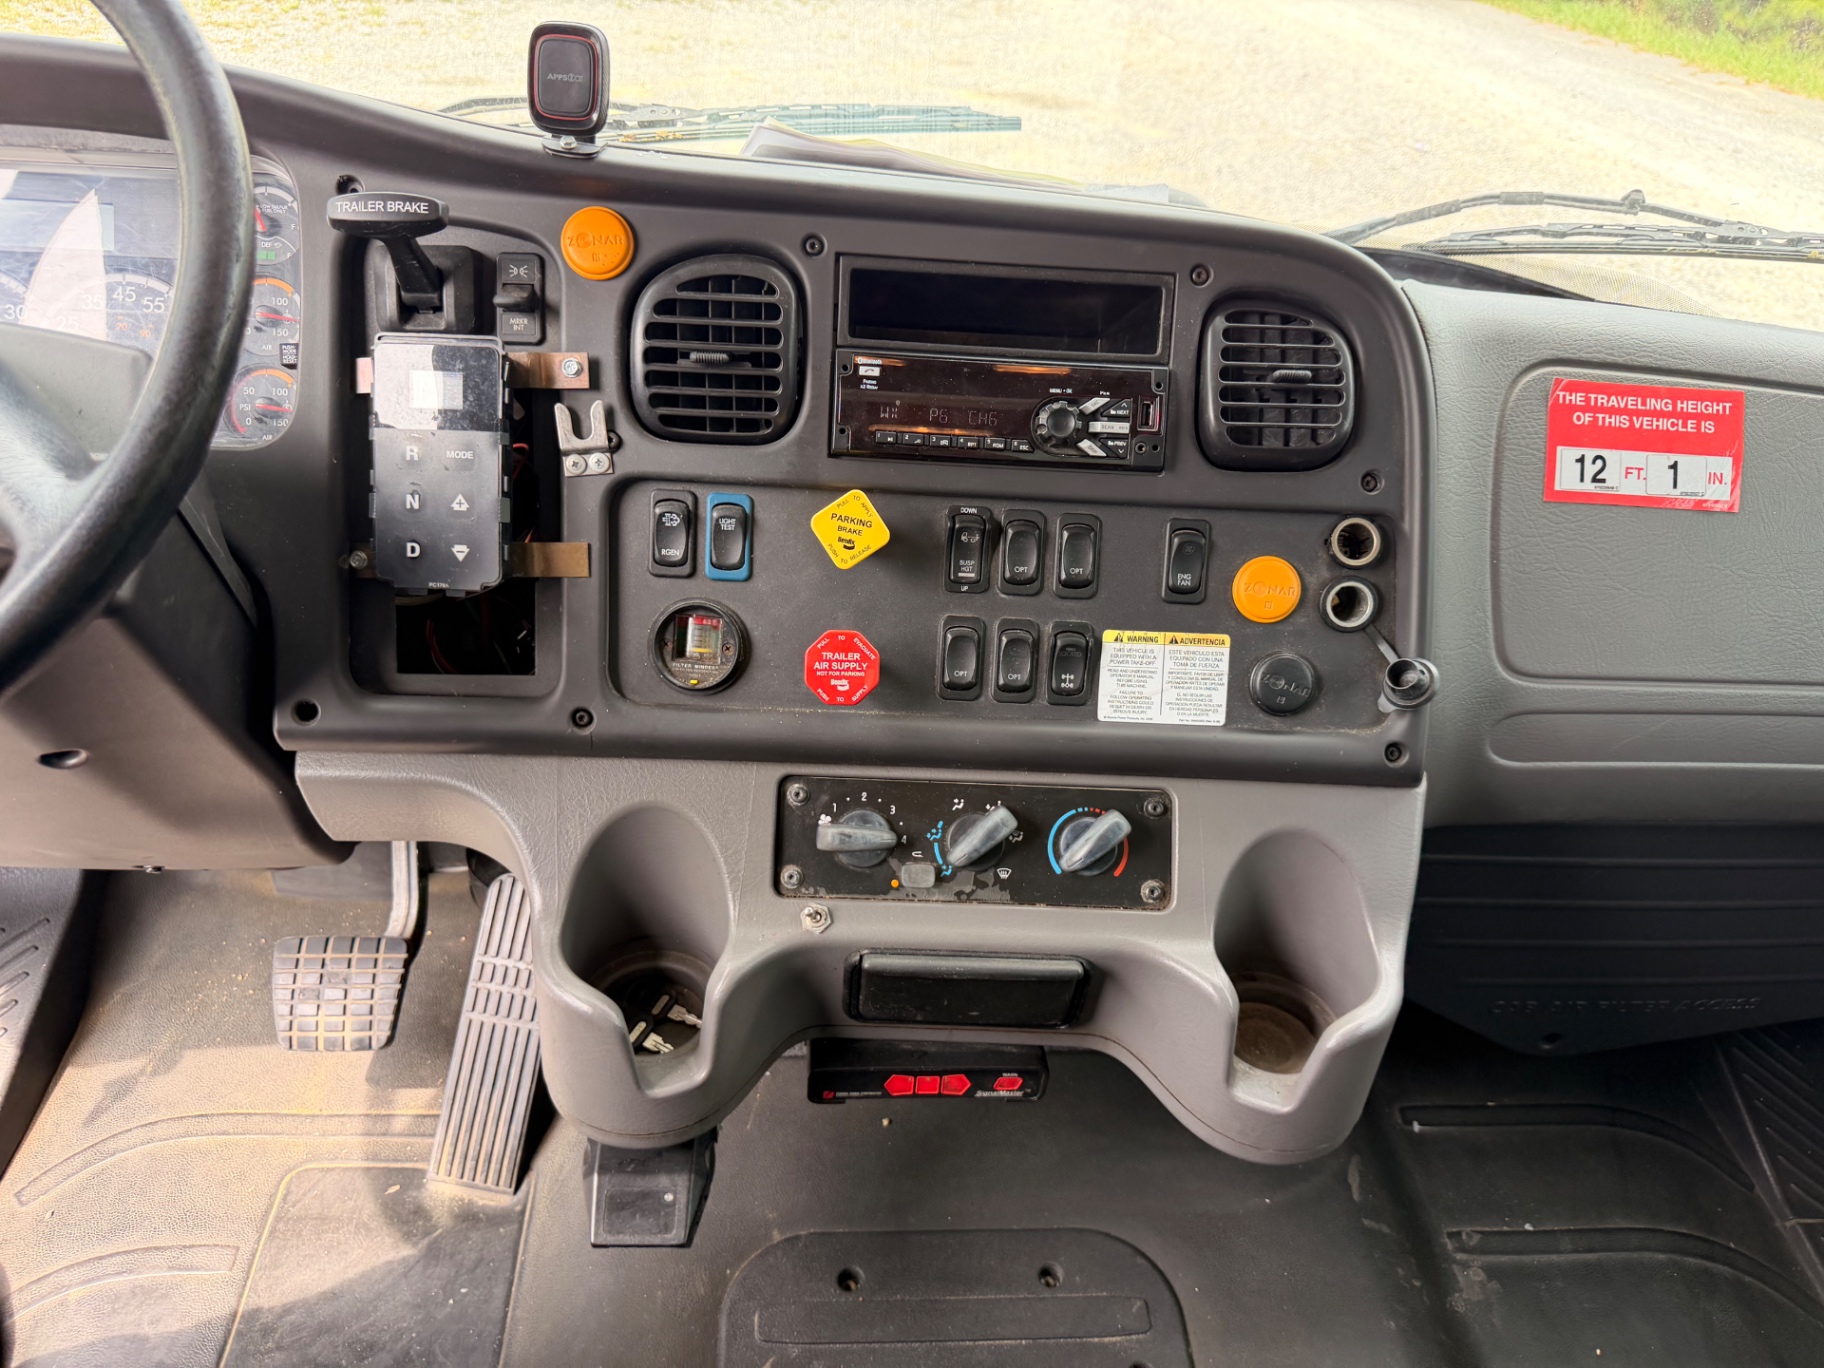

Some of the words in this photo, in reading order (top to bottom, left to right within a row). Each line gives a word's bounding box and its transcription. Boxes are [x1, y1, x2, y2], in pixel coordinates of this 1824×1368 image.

[335, 200, 385, 213] TRAILER
[387, 201, 429, 214] BRAKE
[567, 232, 623, 248] ZONAR
[112, 286, 136, 302] 45
[272, 297, 289, 305] 100
[81, 295, 104, 310] 35
[142, 297, 165, 312] 55
[4, 304, 27, 320] 30
[57, 315, 79, 330] 25
[117, 323, 128, 331] 70
[243, 387, 255, 395] 50
[272, 388, 288, 396] 100
[1556, 391, 1586, 405] THE
[1588, 393, 1673, 412] TRAVELING
[1676, 399, 1732, 415] HEIGHT
[273, 419, 289, 427] 150
[1572, 411, 1594, 425] OF
[1595, 413, 1630, 428] THIS
[1632, 416, 1697, 432] VEHICLE
[1700, 420, 1715, 434] IS
[406, 446, 419, 460] R
[447, 450, 474, 459] MODE
[1575, 453, 1607, 484] 12
[1624, 467, 1647, 481] FT.
[1667, 460, 1679, 490] 1
[1708, 472, 1728, 486] IN.
[406, 495, 420, 509] N
[836, 499, 850, 509] PULL
[861, 502, 873, 518] APPLY
[831, 513, 873, 528] PARKING
[837, 525, 863, 536] BRAKE
[406, 543, 421, 557] D
[661, 548, 680, 556] RGEN
[828, 543, 839, 558] PUSH
[849, 545, 872, 561] RELEASE
[1244, 580, 1295, 597] ZONAR
[1127, 635, 1159, 643] WARNING
[1180, 637, 1226, 646] ADVERTENCIA
[817, 637, 830, 649] PULL
[853, 637, 876, 661] EVACUATE
[821, 652, 861, 660] TRAILER
[813, 661, 829, 670] AIR
[831, 662, 868, 670] SUPPLY
[817, 688, 830, 701] PUSH
[851, 685, 868, 702] SUPPLY
[861, 793, 867, 802] 2
[832, 803, 837, 813] 1
[890, 804, 896, 814] 3
[901, 835, 907, 845] 4
